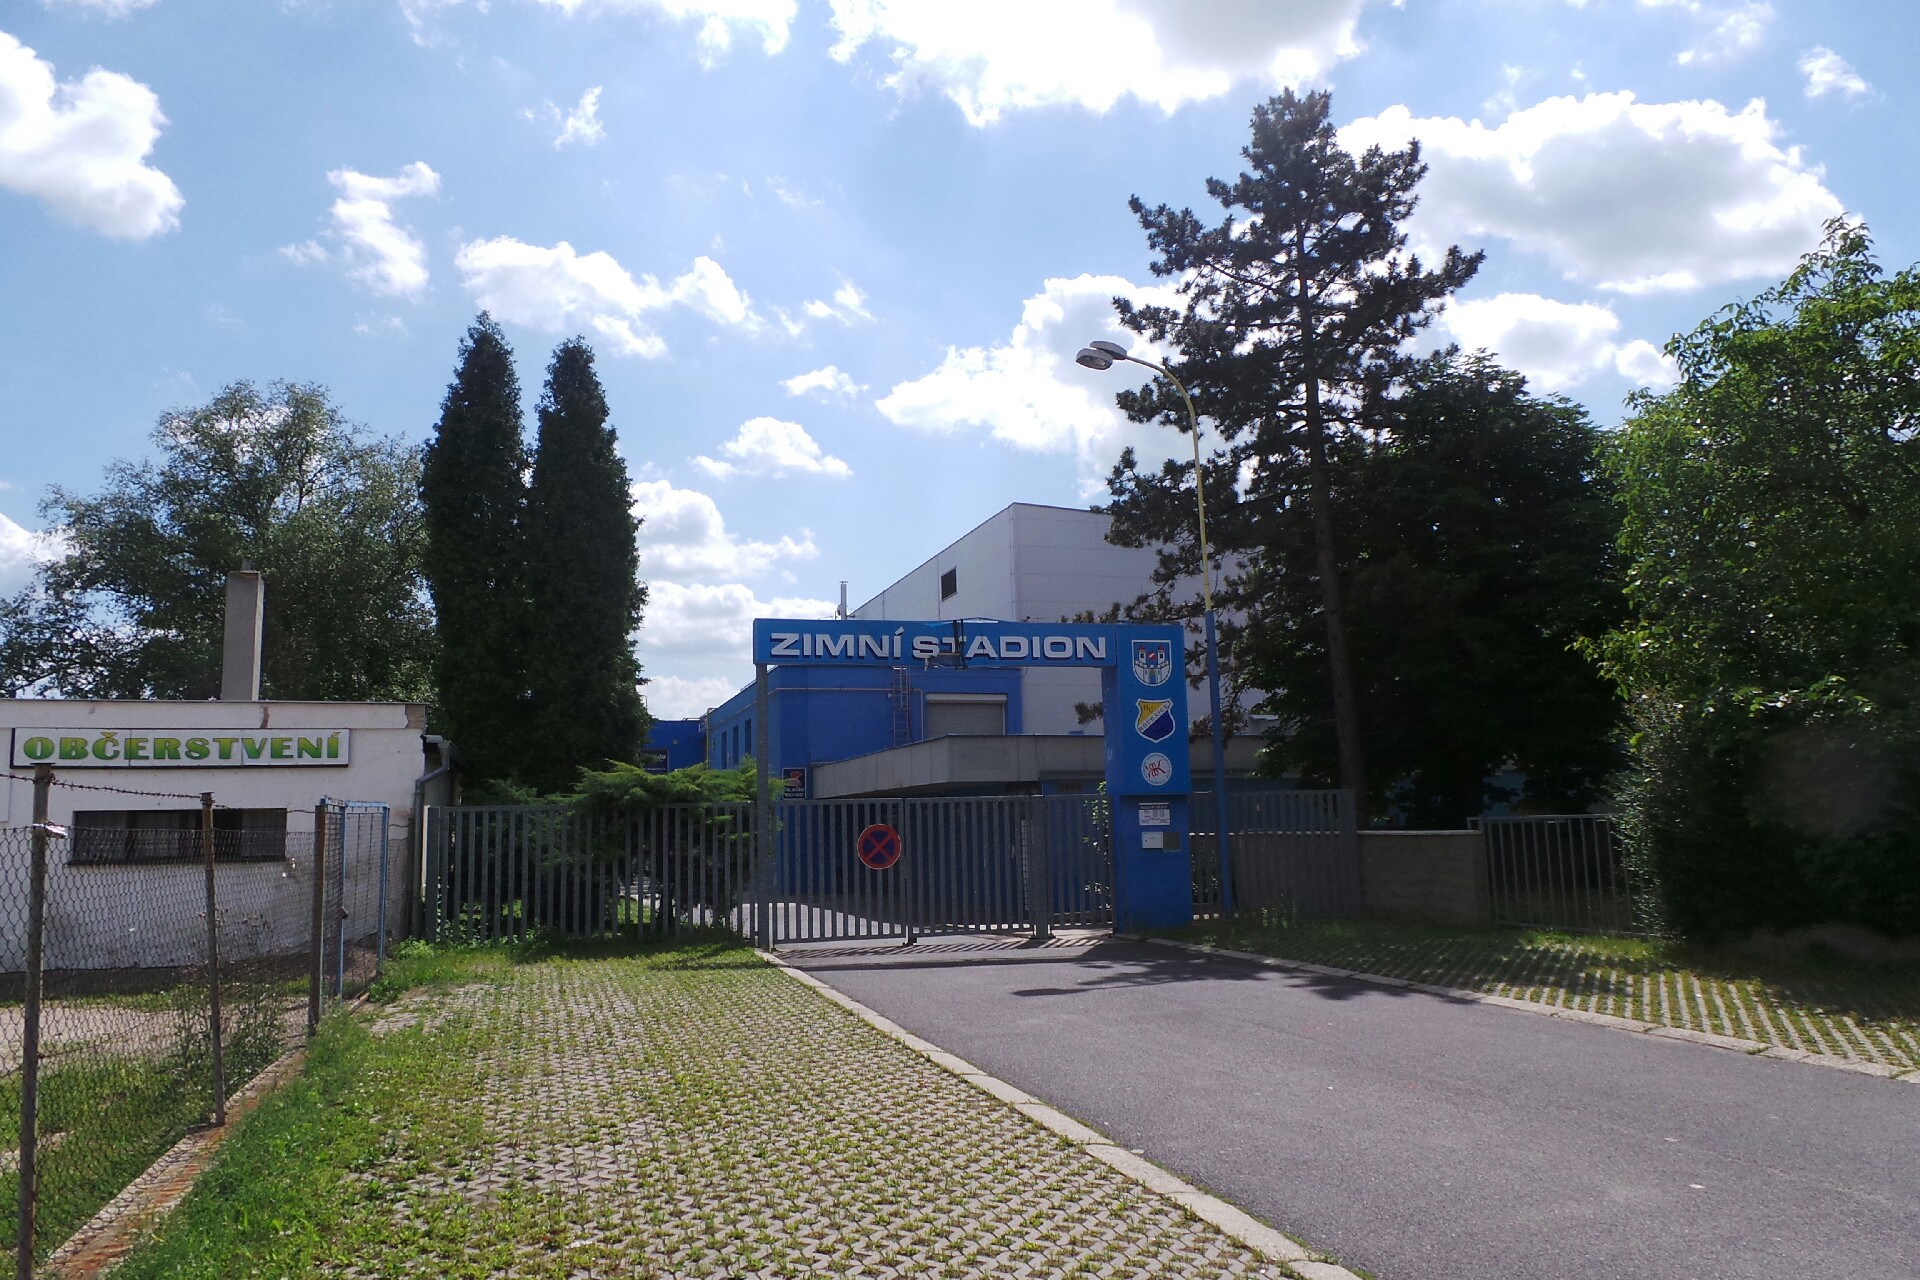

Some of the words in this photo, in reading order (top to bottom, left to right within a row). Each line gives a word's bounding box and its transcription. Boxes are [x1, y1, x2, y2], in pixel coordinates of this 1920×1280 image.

[770, 626, 905, 658] ZIMNÍ
[912, 635, 1106, 659] STADION
[23, 731, 342, 759] OBČERSTVENÍ
